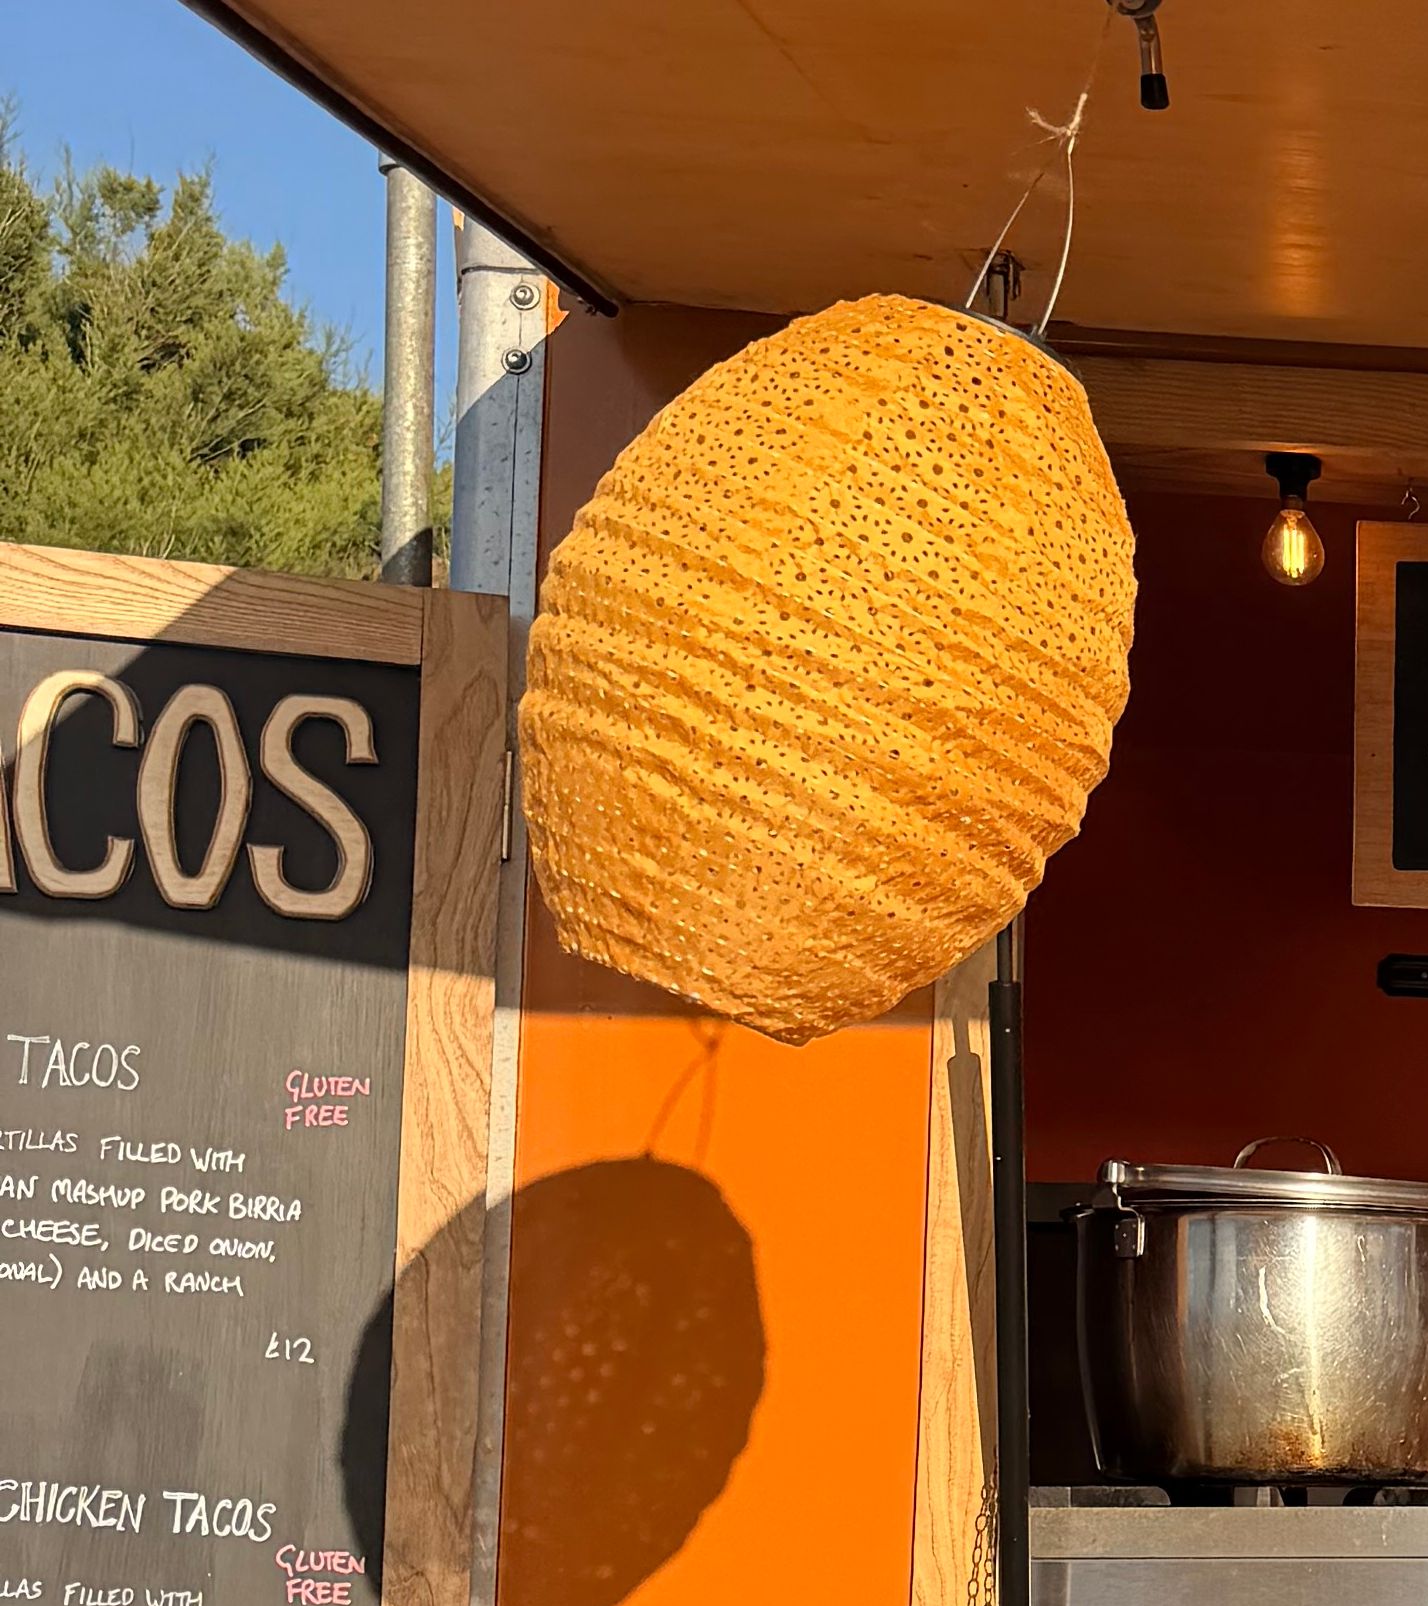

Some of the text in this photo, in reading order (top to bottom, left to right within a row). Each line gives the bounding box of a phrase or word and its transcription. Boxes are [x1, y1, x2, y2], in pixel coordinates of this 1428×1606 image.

[0, 668, 380, 920] COS
[7, 1034, 141, 1090] TACOS
[284, 1070, 371, 1102] GLUTEN
[284, 1105, 349, 1129] FREE
[100, 1136, 181, 1164] FILLED
[190, 1148, 246, 1173] WITH
[51, 1179, 145, 1210] MASHUP
[160, 1186, 221, 1215] PORK
[228, 1193, 302, 1221] BIRRIA
[2, 1219, 109, 1251] CHEESE,
[129, 1229, 198, 1253] DICED
[78, 1267, 122, 1290] AND
[132, 1270, 149, 1291] A
[165, 1271, 244, 1296] RANCH
[265, 1332, 315, 1363] £12
[0, 1479, 278, 1542] CHICKEN TACOS
[276, 1544, 366, 1577] GLUTEN
[64, 1582, 134, 1606] FILLED
[286, 1579, 352, 1606] FREE
